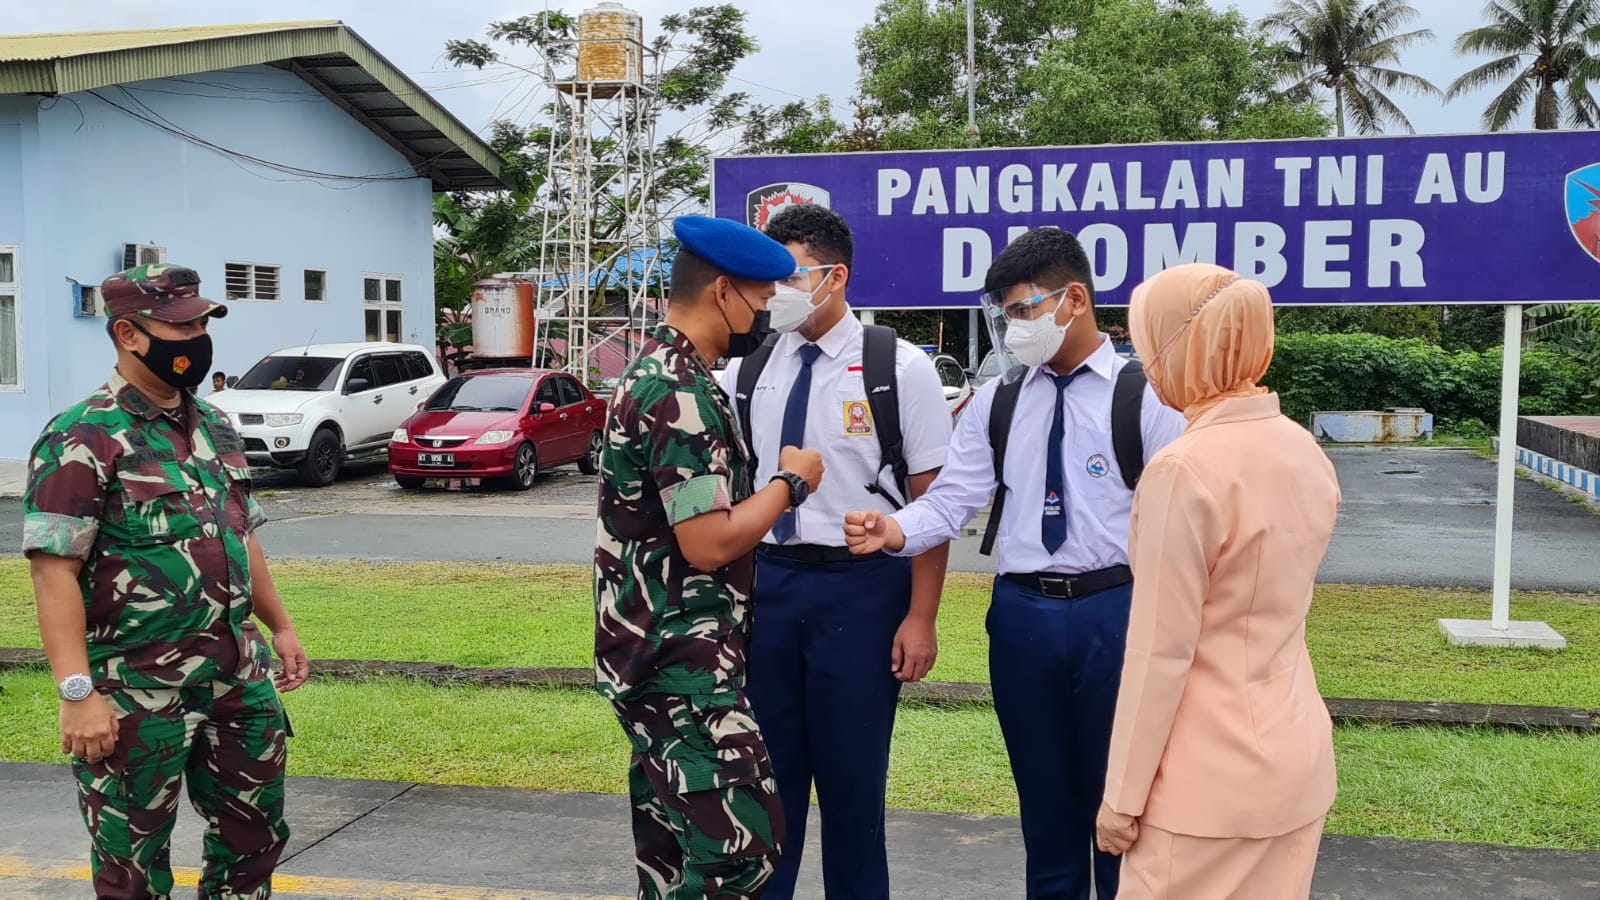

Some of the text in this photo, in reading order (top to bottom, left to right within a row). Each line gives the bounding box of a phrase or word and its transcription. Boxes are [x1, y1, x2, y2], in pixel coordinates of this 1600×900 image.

[877, 151, 1505, 216] PANGKALAN TNI AU
[942, 218, 1428, 292] DOMBER
